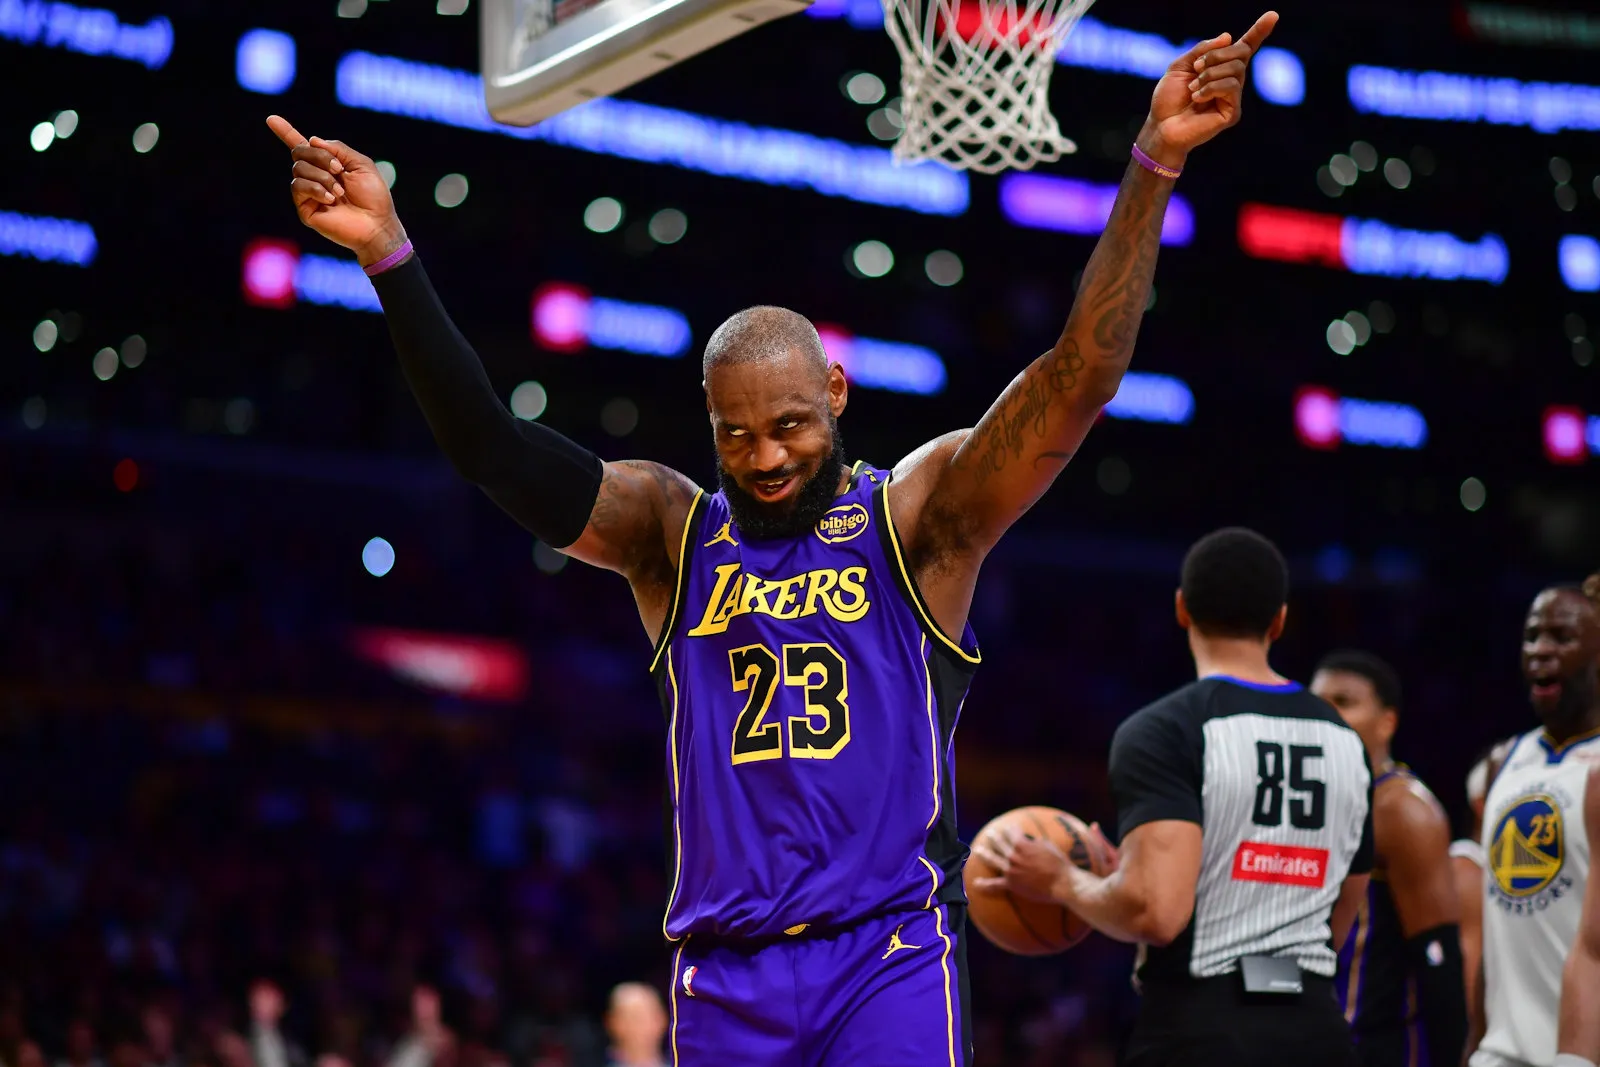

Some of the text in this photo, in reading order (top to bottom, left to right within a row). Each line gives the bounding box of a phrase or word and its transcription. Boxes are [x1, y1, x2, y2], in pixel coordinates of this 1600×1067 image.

[820, 513, 866, 530] bibigo
[687, 563, 870, 637] LAKERS
[728, 642, 851, 766] 23
[1252, 740, 1327, 830] 85
[1529, 813, 1557, 848] 23
[1240, 848, 1320, 878] Emirates
